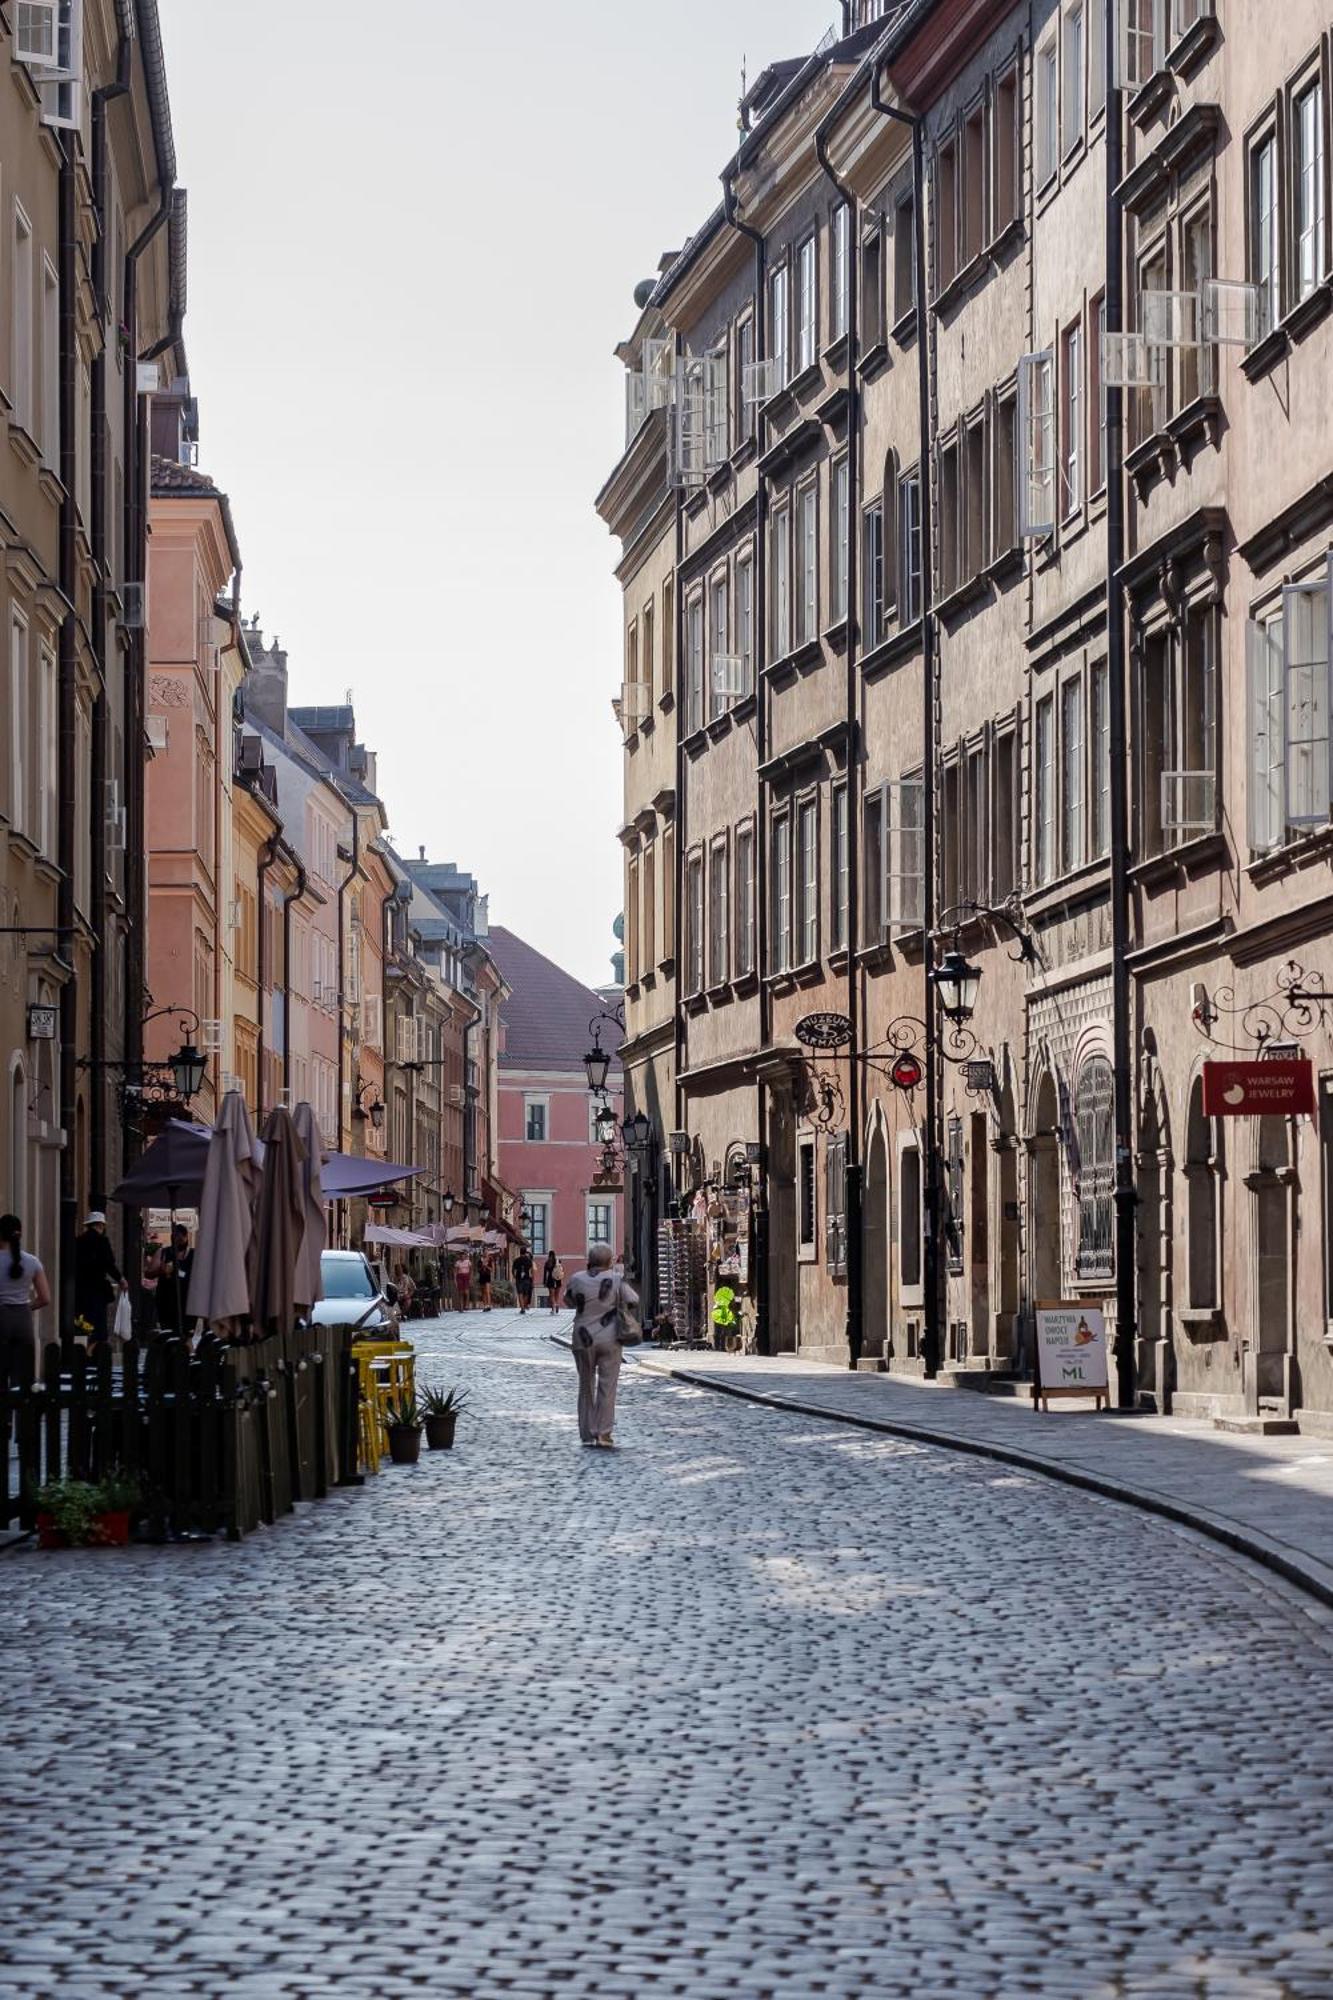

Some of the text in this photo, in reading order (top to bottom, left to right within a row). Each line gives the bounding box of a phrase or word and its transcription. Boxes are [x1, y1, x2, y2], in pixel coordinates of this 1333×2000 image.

[801, 1015, 851, 1029] MUZEUM
[1247, 1077, 1295, 1086] WARSAW
[1248, 1089, 1295, 1098] JEWELRY
[1062, 1366, 1086, 1379] ML
